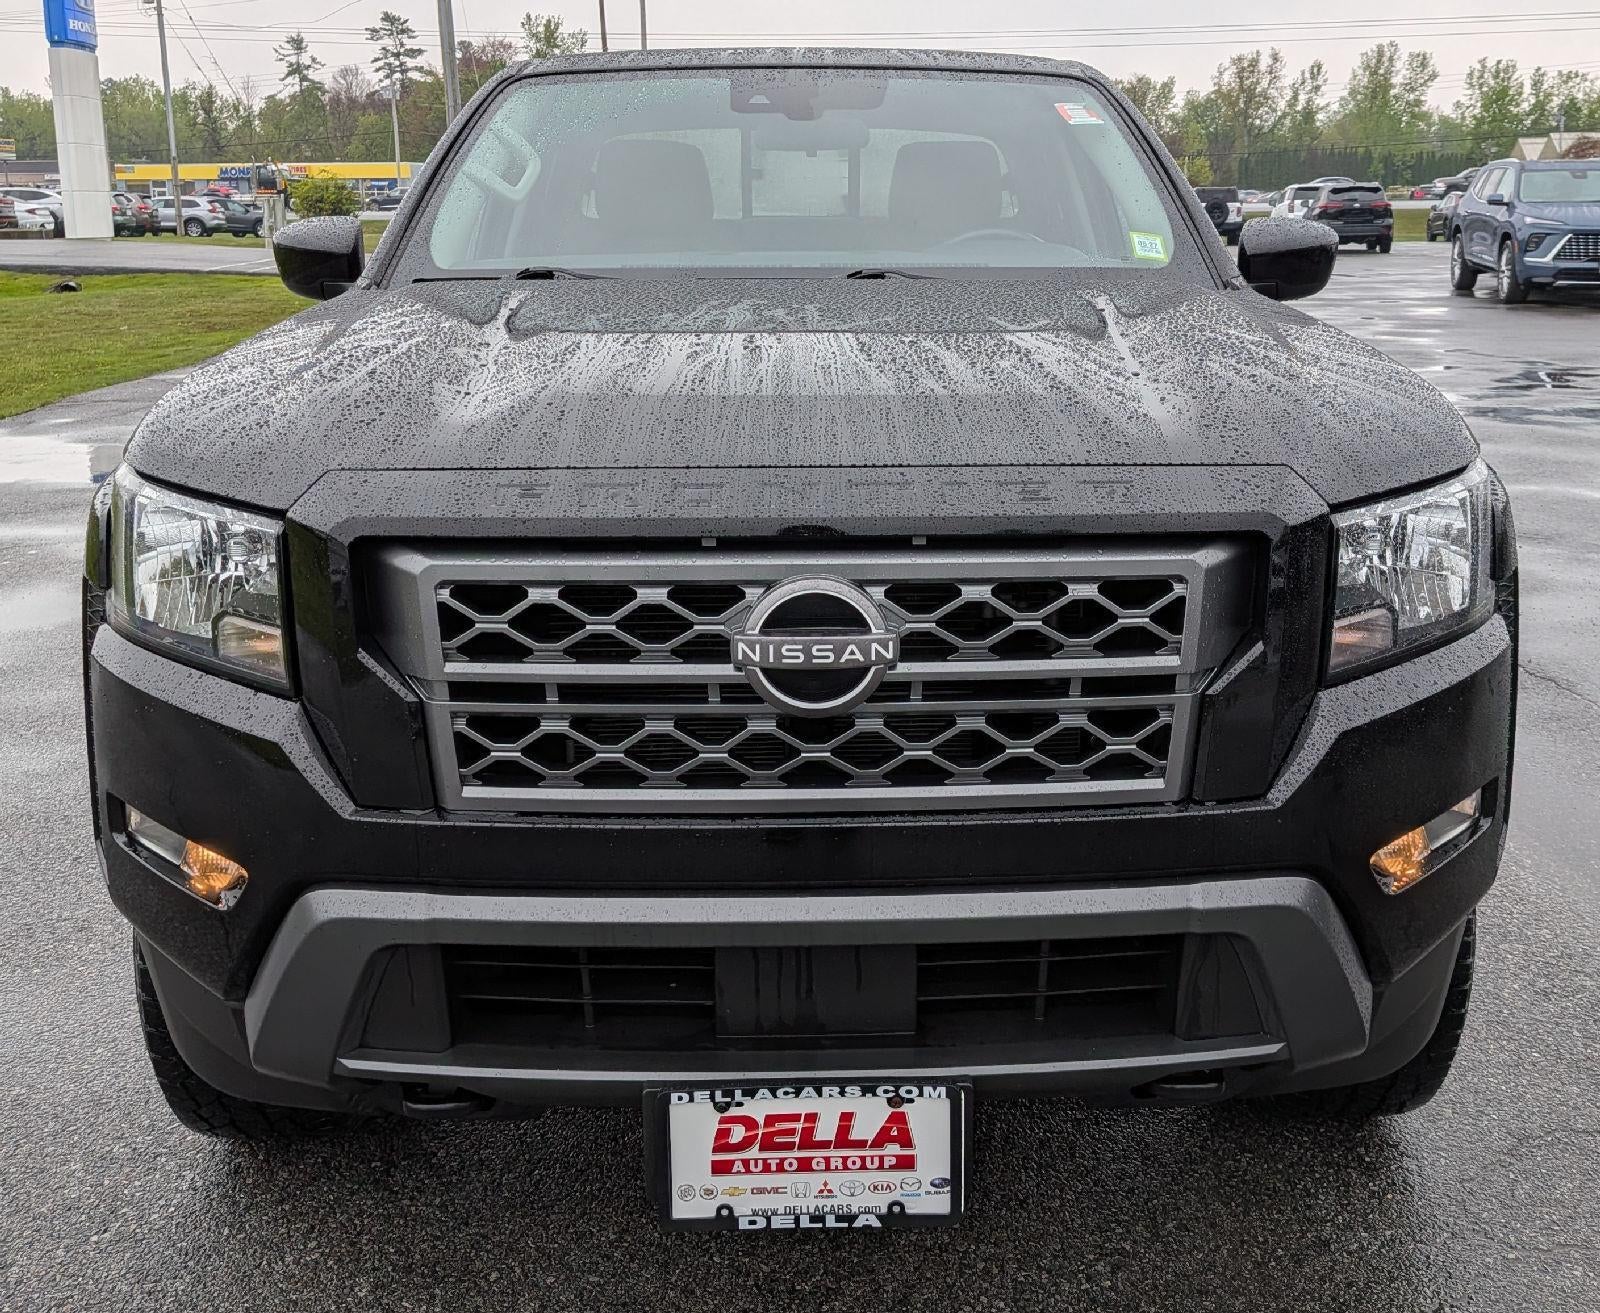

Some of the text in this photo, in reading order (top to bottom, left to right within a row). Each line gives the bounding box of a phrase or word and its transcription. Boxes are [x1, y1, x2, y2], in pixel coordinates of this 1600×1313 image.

[737, 640, 894, 663] NISSAN
[670, 1085, 947, 1104] DELLACARS.COM
[711, 1110, 917, 1155] DELLA
[731, 1156, 897, 1173] AUTO GROUP
[750, 1186, 788, 1195] GMC
[872, 1183, 893, 1192] KIA
[751, 1203, 882, 1216] www.DELLACARS.com
[738, 1213, 882, 1230] DELLA
